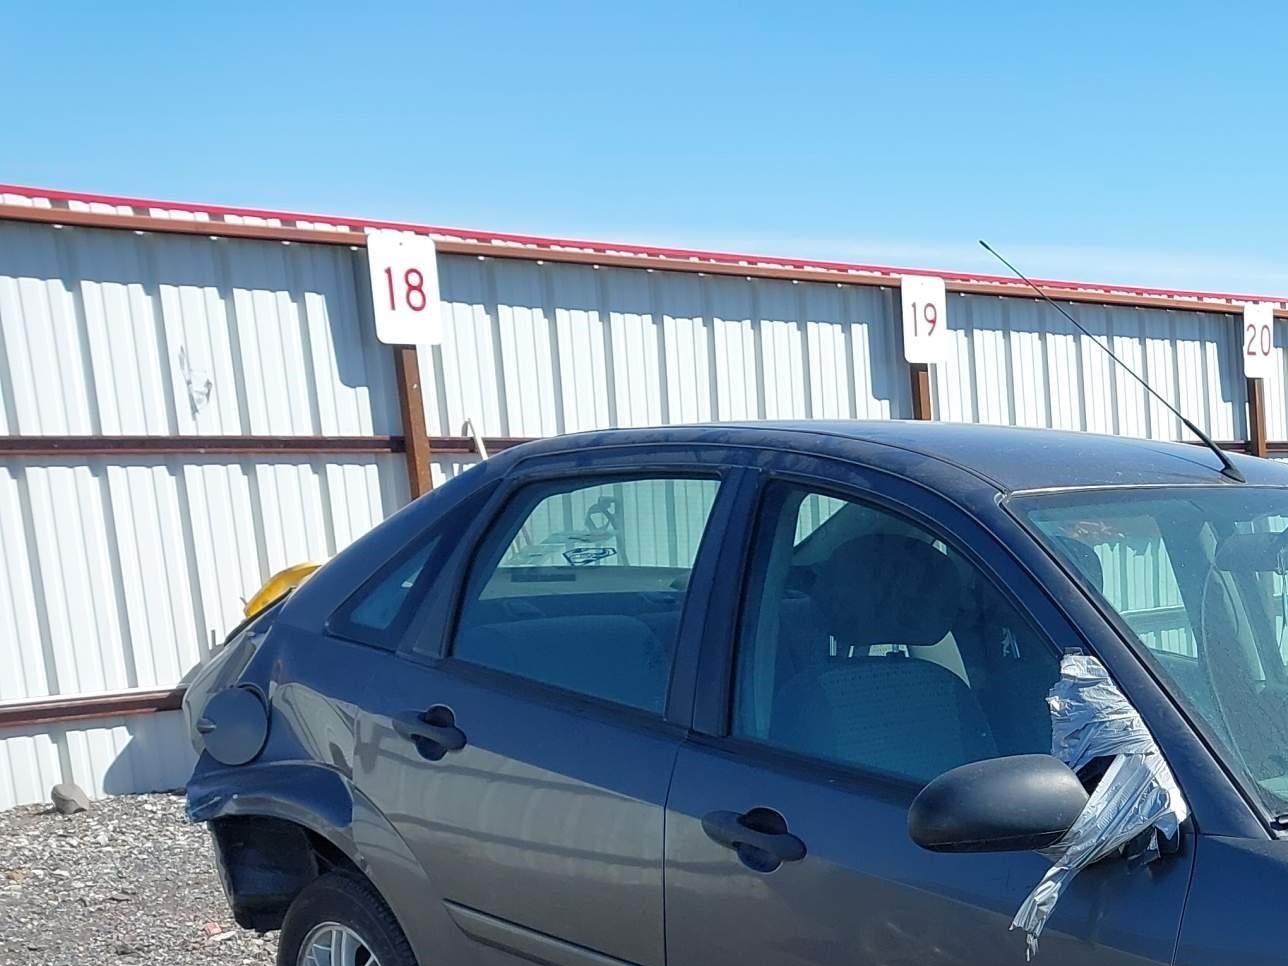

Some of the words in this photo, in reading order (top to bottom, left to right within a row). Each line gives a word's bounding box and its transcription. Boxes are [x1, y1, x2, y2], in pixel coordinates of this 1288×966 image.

[383, 266, 427, 312] 18
[910, 301, 938, 338] 19
[1246, 323, 1271, 356] 20
